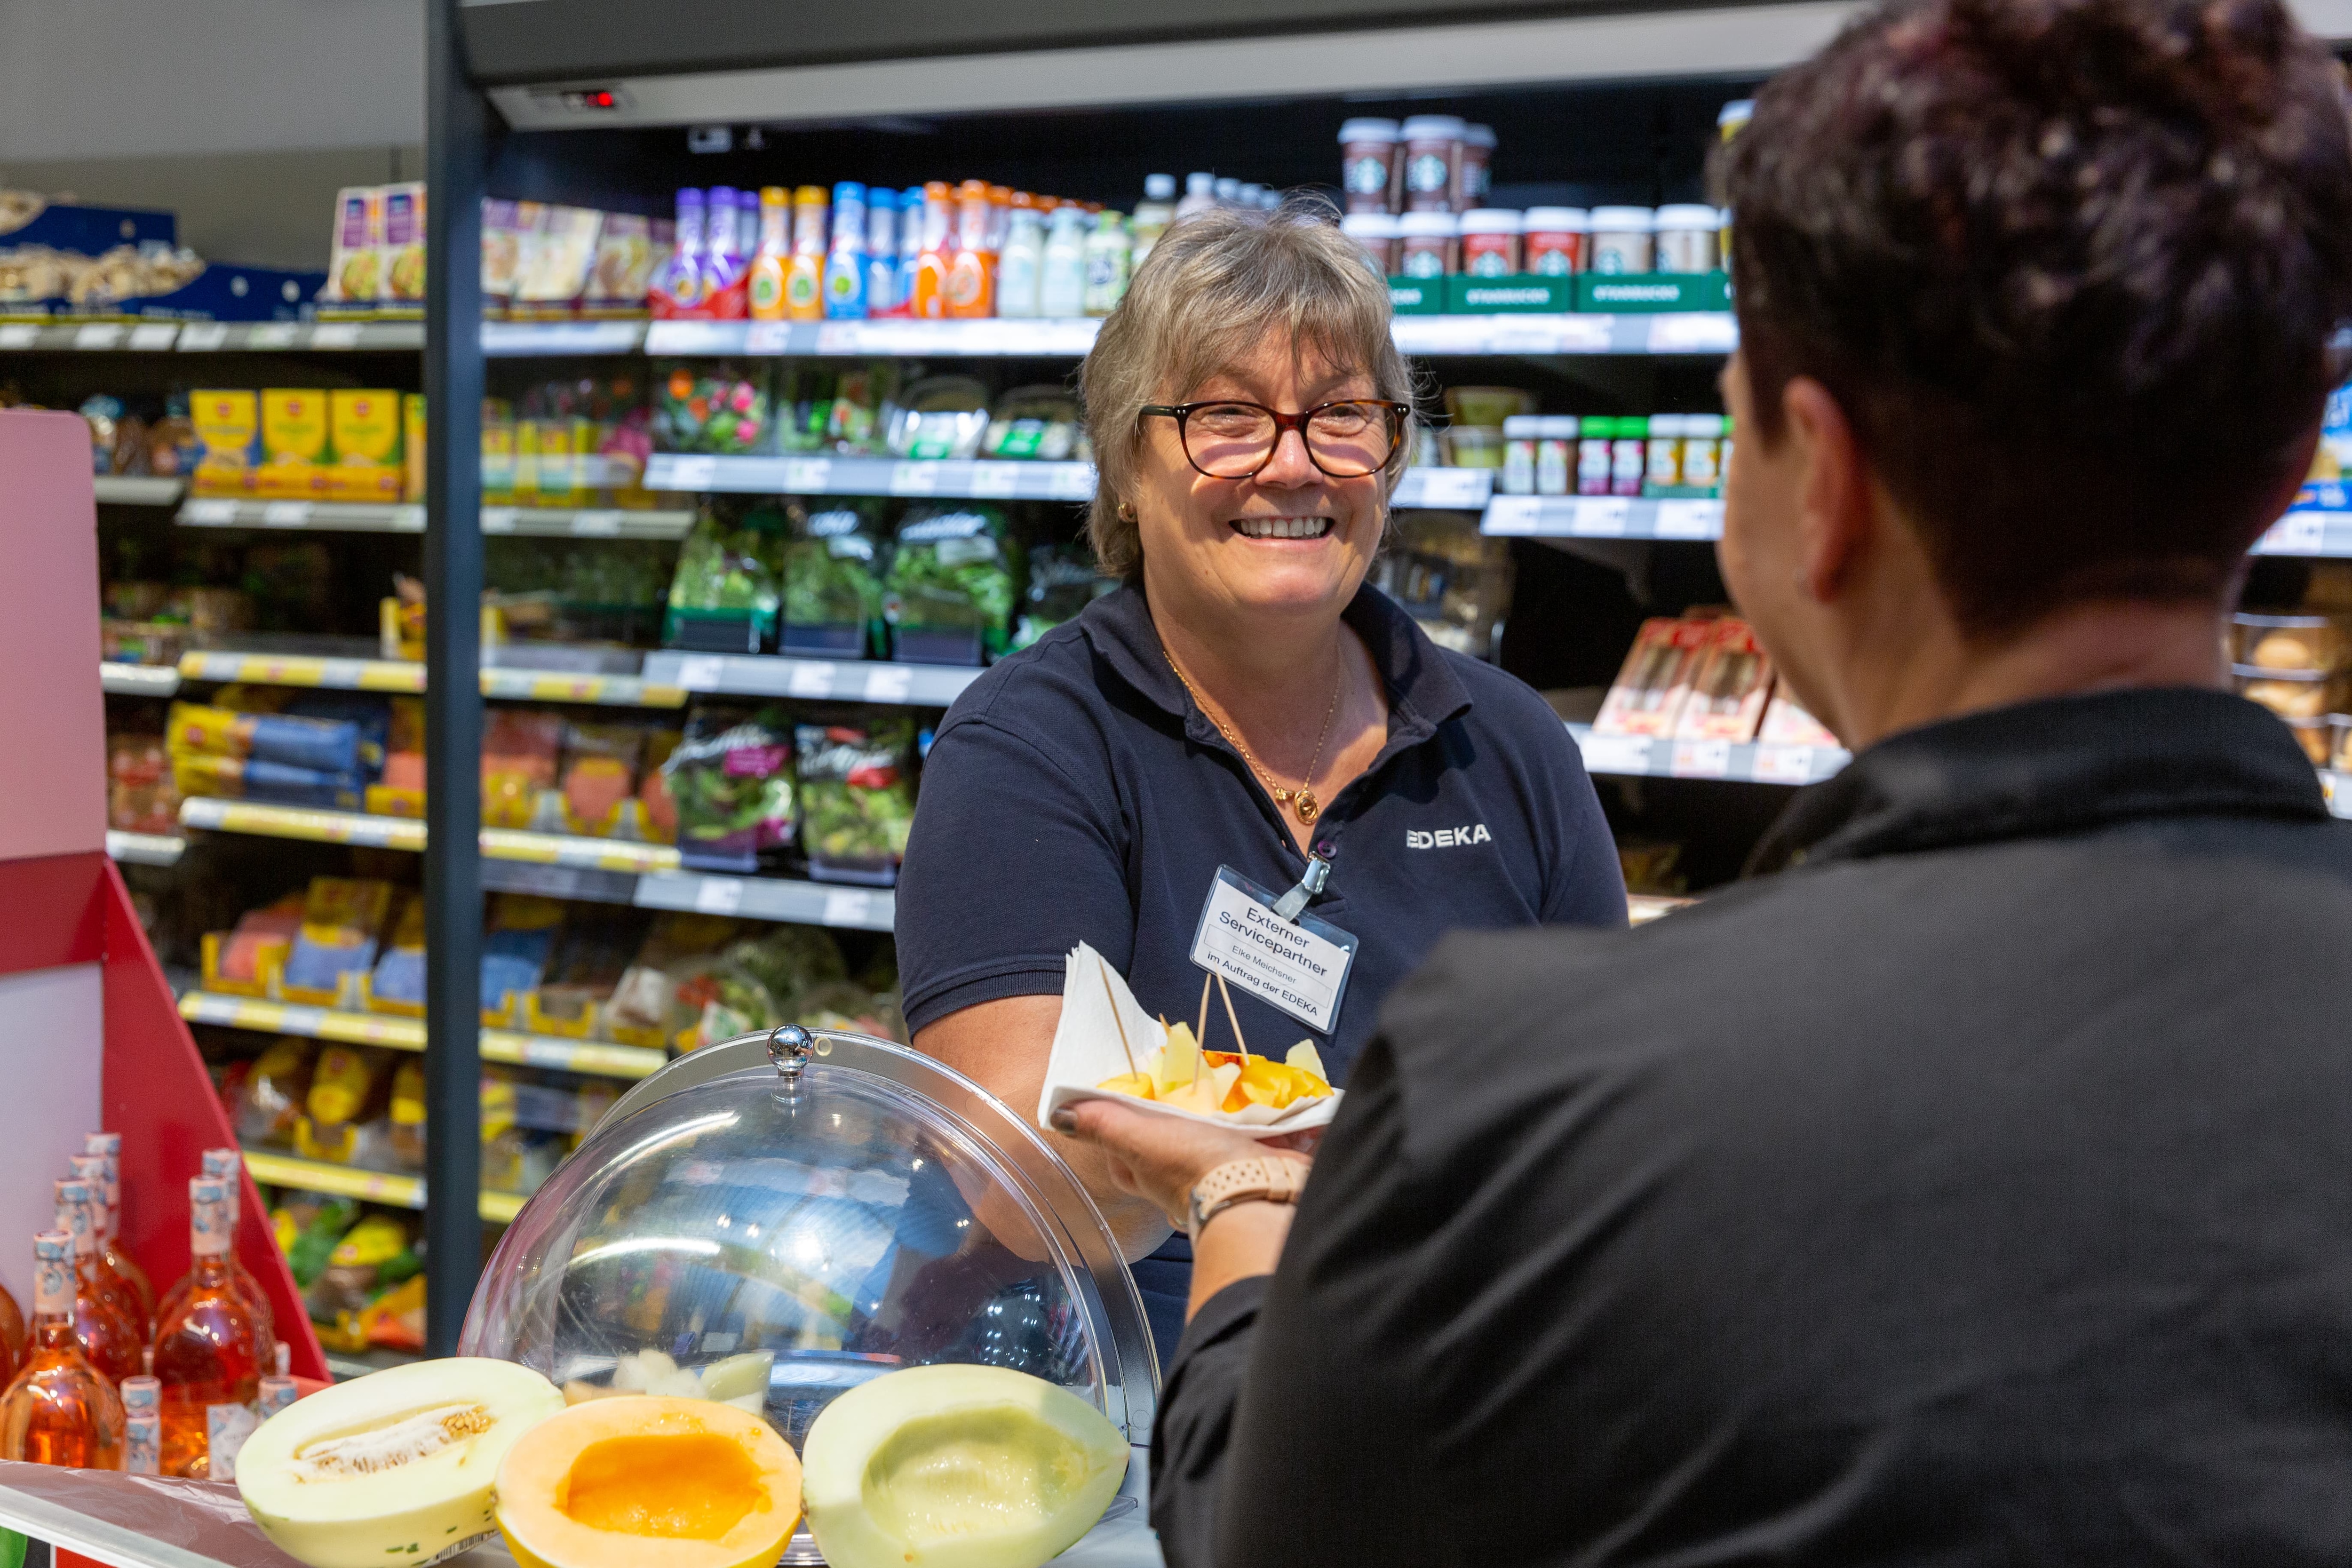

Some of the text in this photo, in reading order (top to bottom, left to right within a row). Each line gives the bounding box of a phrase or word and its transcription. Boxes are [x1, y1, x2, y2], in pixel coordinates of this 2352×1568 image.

[1406, 824, 1491, 850] EDEKA
[1219, 911, 1327, 977] Servicepartner
[1247, 907, 1310, 948] Externer
[1208, 951, 1318, 1016] im Auftrag der EDEKA
[1232, 945, 1297, 984] Elke Meichsner
